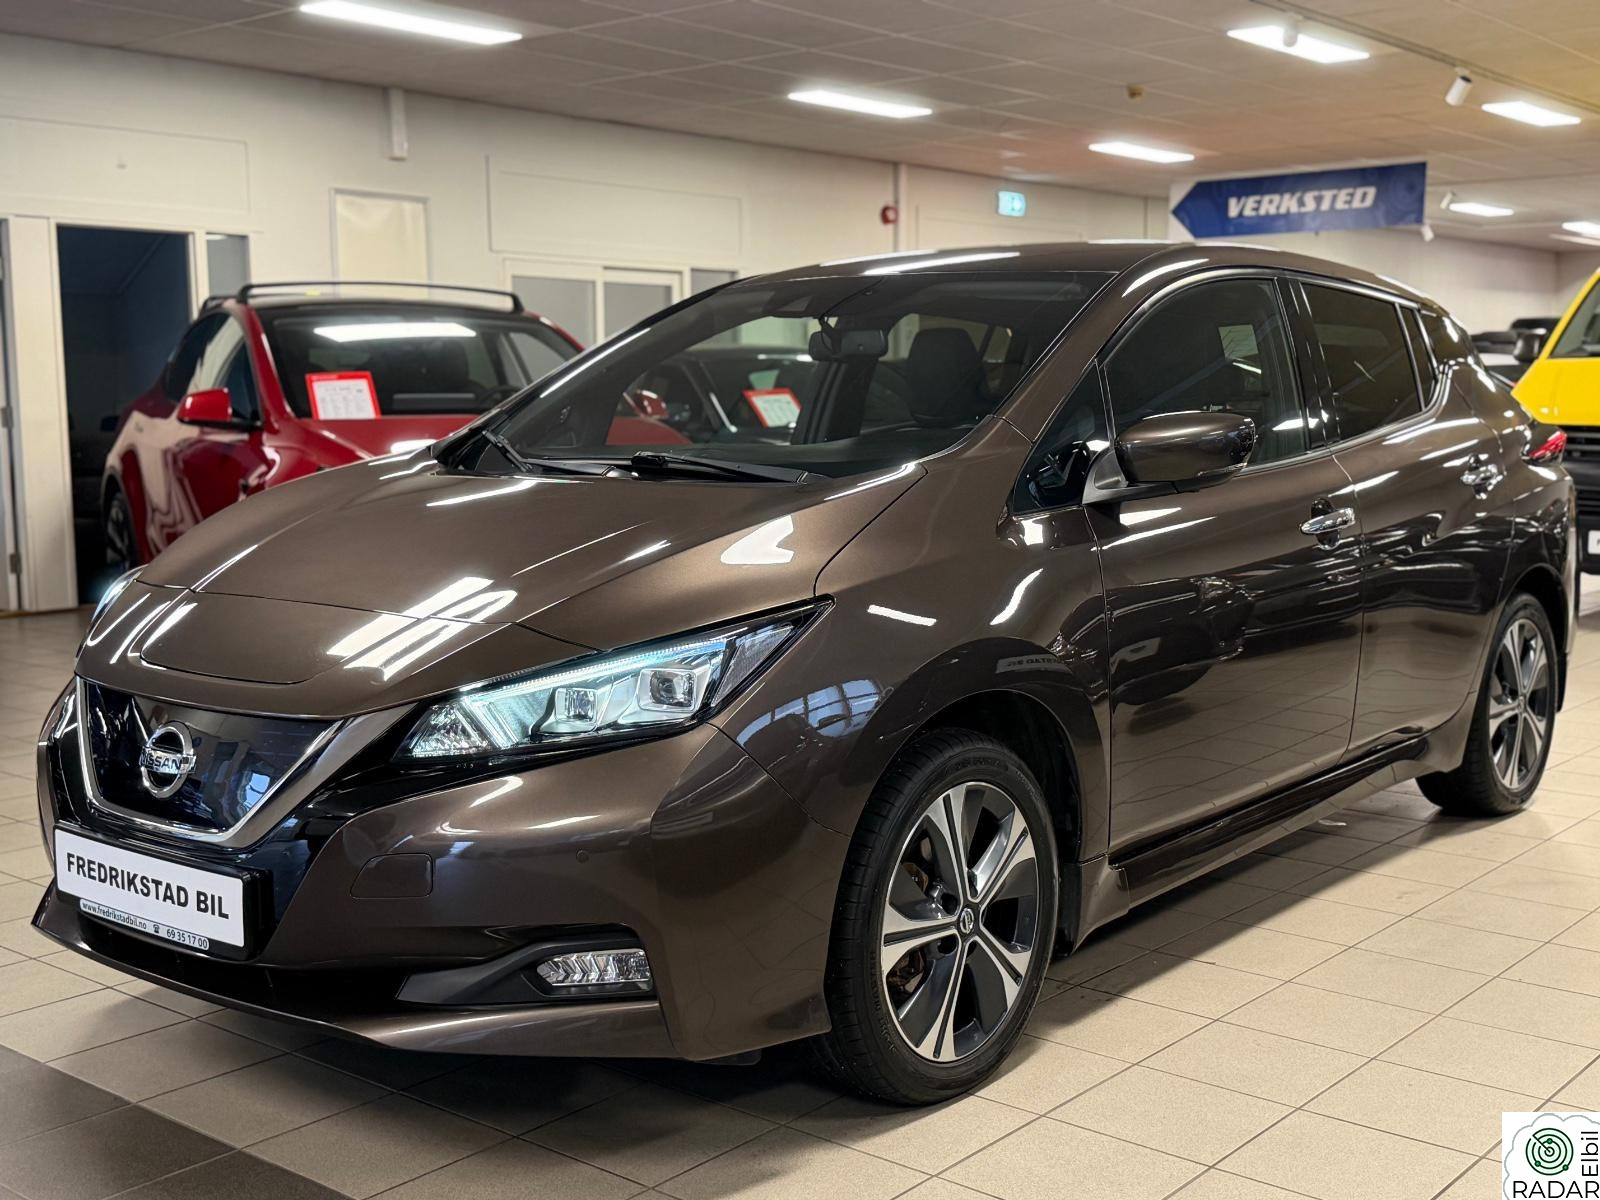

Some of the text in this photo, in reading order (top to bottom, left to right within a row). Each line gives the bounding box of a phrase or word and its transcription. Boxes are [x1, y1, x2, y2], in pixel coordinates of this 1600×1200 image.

[1228, 186, 1377, 218] VERKSTED
[140, 749, 182, 771] NISSAN
[66, 852, 229, 920] FREDRIKSTAD BIL
[82, 901, 208, 949] www.fredrikstadbil.no 69 35 17 00
